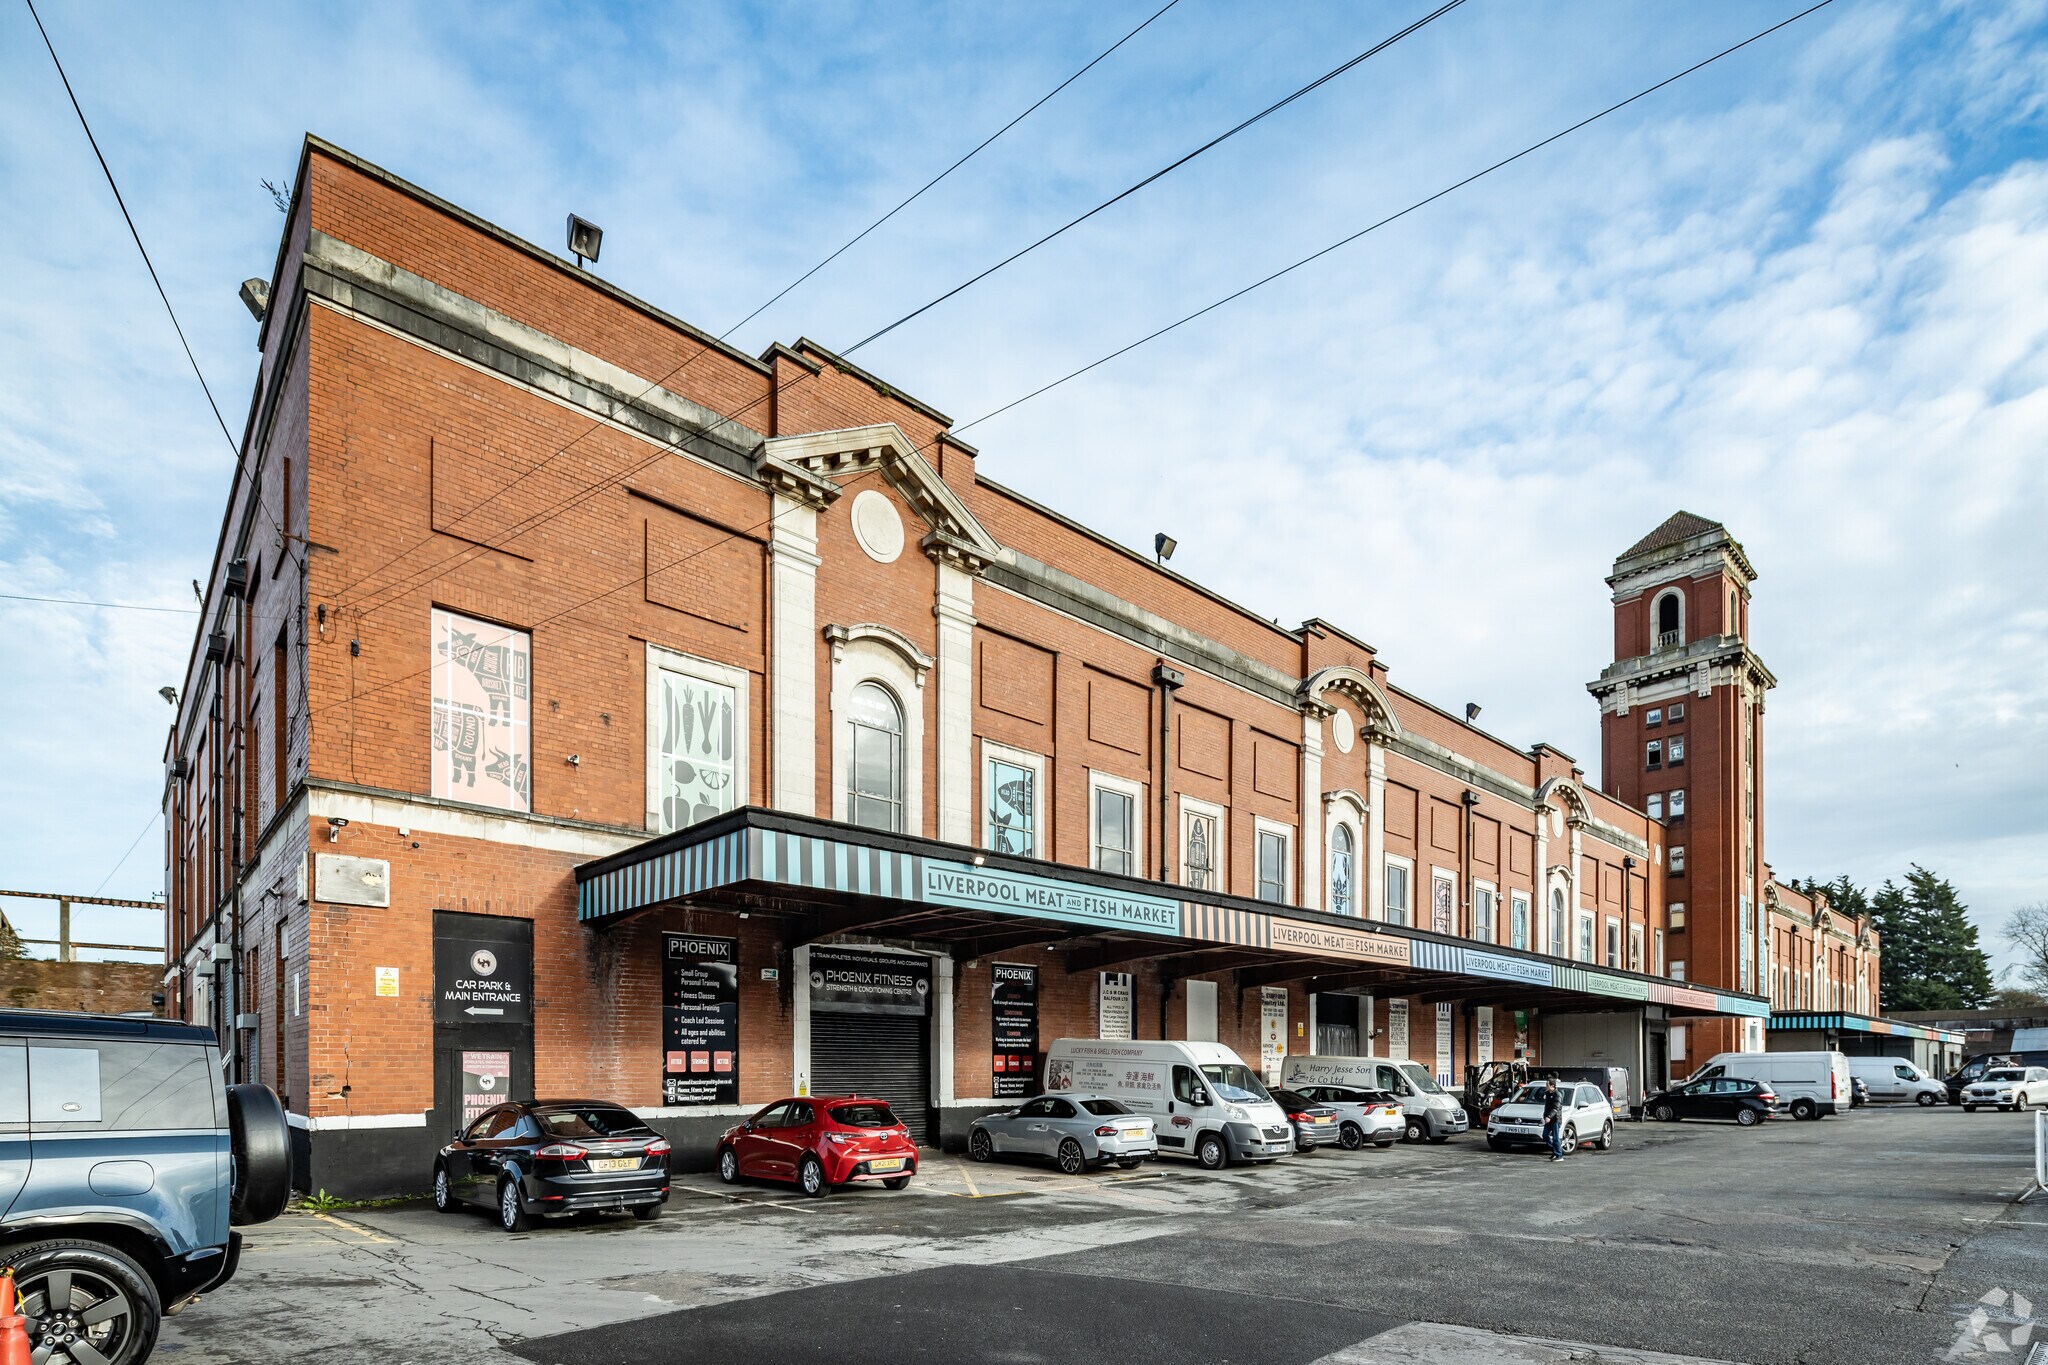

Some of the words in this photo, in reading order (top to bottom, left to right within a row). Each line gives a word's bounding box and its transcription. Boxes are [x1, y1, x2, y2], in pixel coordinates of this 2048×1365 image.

[463, 716, 477, 749] ROUND
[928, 872, 1020, 902] LIVERPOOL
[1026, 888, 1064, 908] MEAT
[1066, 898, 1082, 908] AND
[1084, 897, 1117, 916] FISH
[1122, 903, 1176, 925] MARKET
[1273, 927, 1322, 946] LIVERPOOL
[1324, 935, 1345, 949] MEAT
[1355, 940, 1375, 953] FISH
[1377, 944, 1408, 957] MARKET
[670, 940, 728, 956] PHOENIX
[1465, 956, 1496, 970] LIVERPOOL
[1496, 962, 1510, 972] MEAT
[1516, 966, 1529, 975] FISH
[1530, 968, 1551, 979] MARKET
[681, 968, 694, 977] Small
[695, 969, 709, 979] Group
[826, 970, 872, 984] PHOENIX
[873, 973, 913, 986] FITNESS
[996, 968, 1032, 980] PHOENIX
[455, 980, 477, 990] CAR
[478, 980, 503, 991] PARK
[504, 982, 512, 991] &
[681, 977, 702, 986] Personal
[702, 979, 720, 988] Training
[681, 990, 698, 999] Fitness
[698, 992, 716, 1000] Classes
[826, 983, 854, 992] STRENGTH
[858, 986, 893, 995] CONDITIONING
[893, 987, 912, 996] CENTRE
[445, 991, 471, 1001] MAIN
[472, 992, 521, 1003] ENTRANCE
[681, 1002, 702, 1011] Personal
[702, 1003, 720, 1013] Training
[681, 1016, 696, 1024] Coach
[696, 1016, 705, 1024] Led
[705, 1017, 725, 1025] Sessions
[688, 1029, 700, 1038] ages
[708, 1029, 726, 1037] abilities
[681, 1037, 700, 1045] catered
[700, 1037, 708, 1045] for
[1121, 1049, 1143, 1057] COMPANY
[1309, 1064, 1332, 1074] Harry
[1332, 1065, 1354, 1074] Jesse
[1355, 1066, 1371, 1074] Son
[1317, 1076, 1328, 1084] Co
[1330, 1076, 1345, 1084] Ltd
[464, 1094, 506, 1106] PHOENIX
